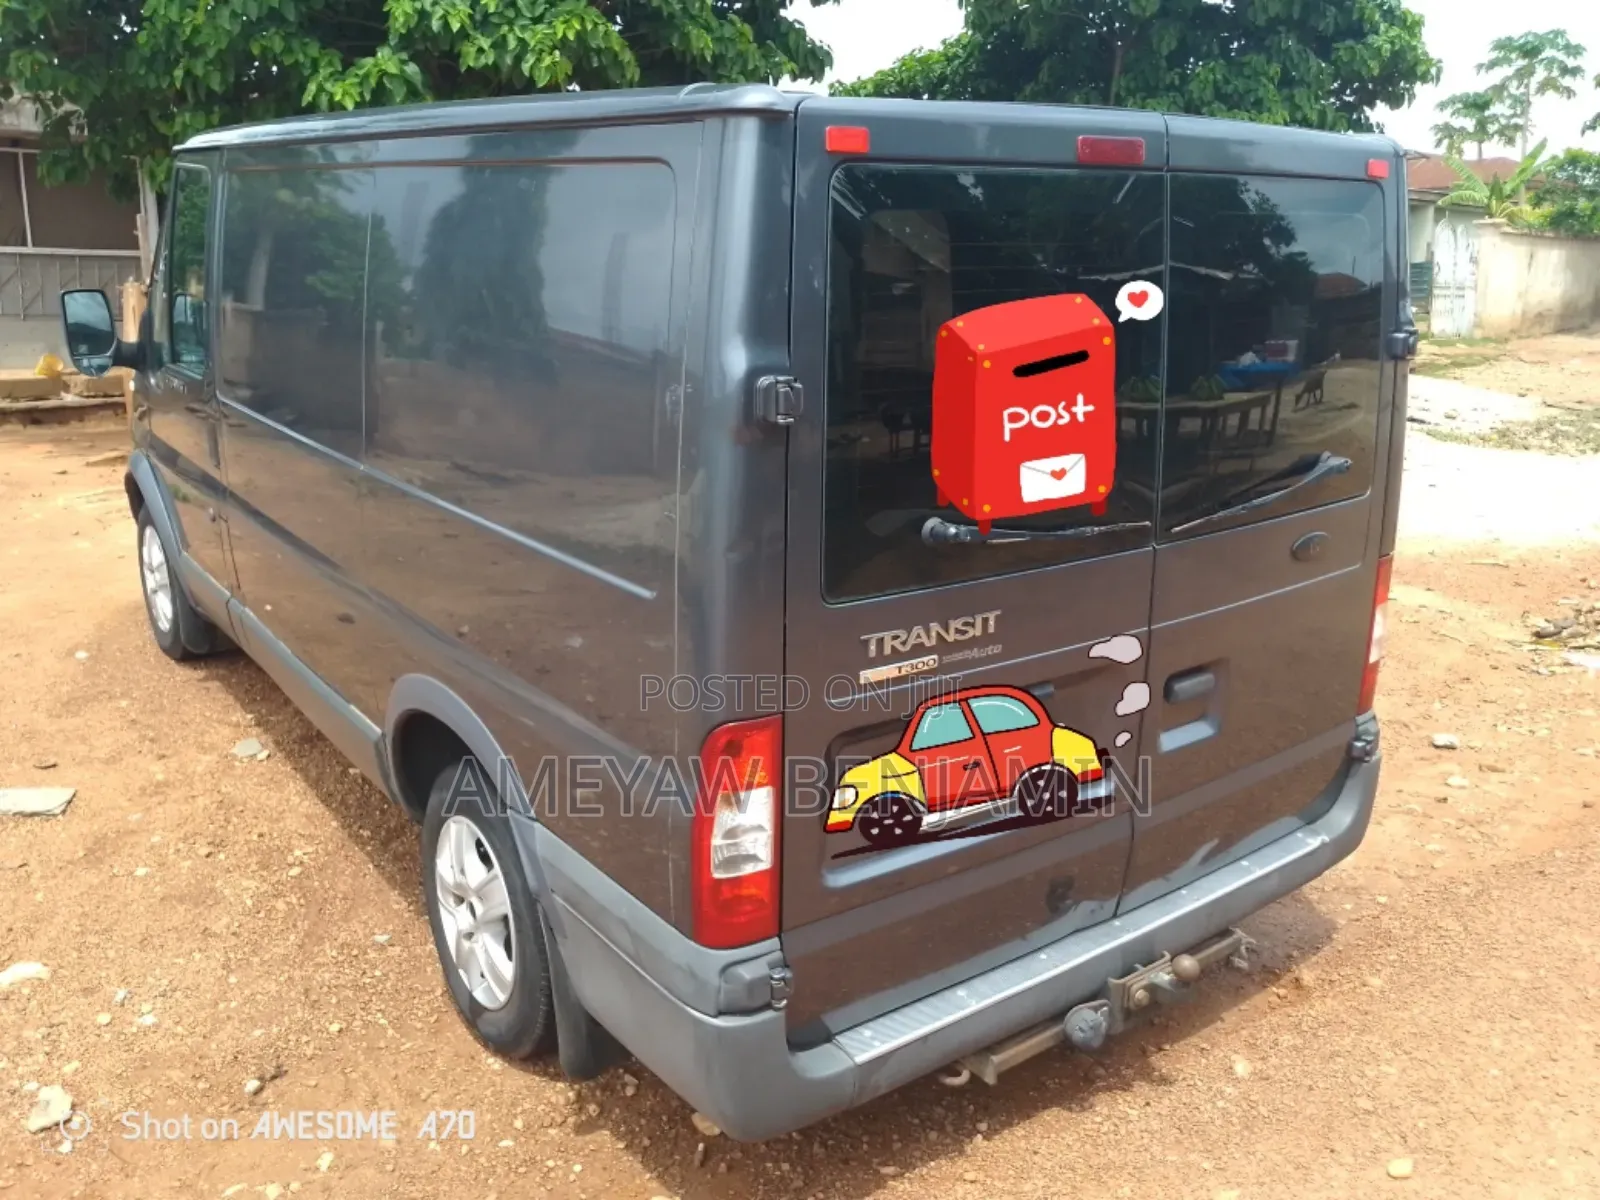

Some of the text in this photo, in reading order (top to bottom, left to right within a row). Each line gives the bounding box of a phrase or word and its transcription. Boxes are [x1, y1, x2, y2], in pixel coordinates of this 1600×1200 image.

[1002, 392, 1095, 442] post
[859, 609, 1002, 658] TRANSIT
[896, 658, 937, 675] T300
